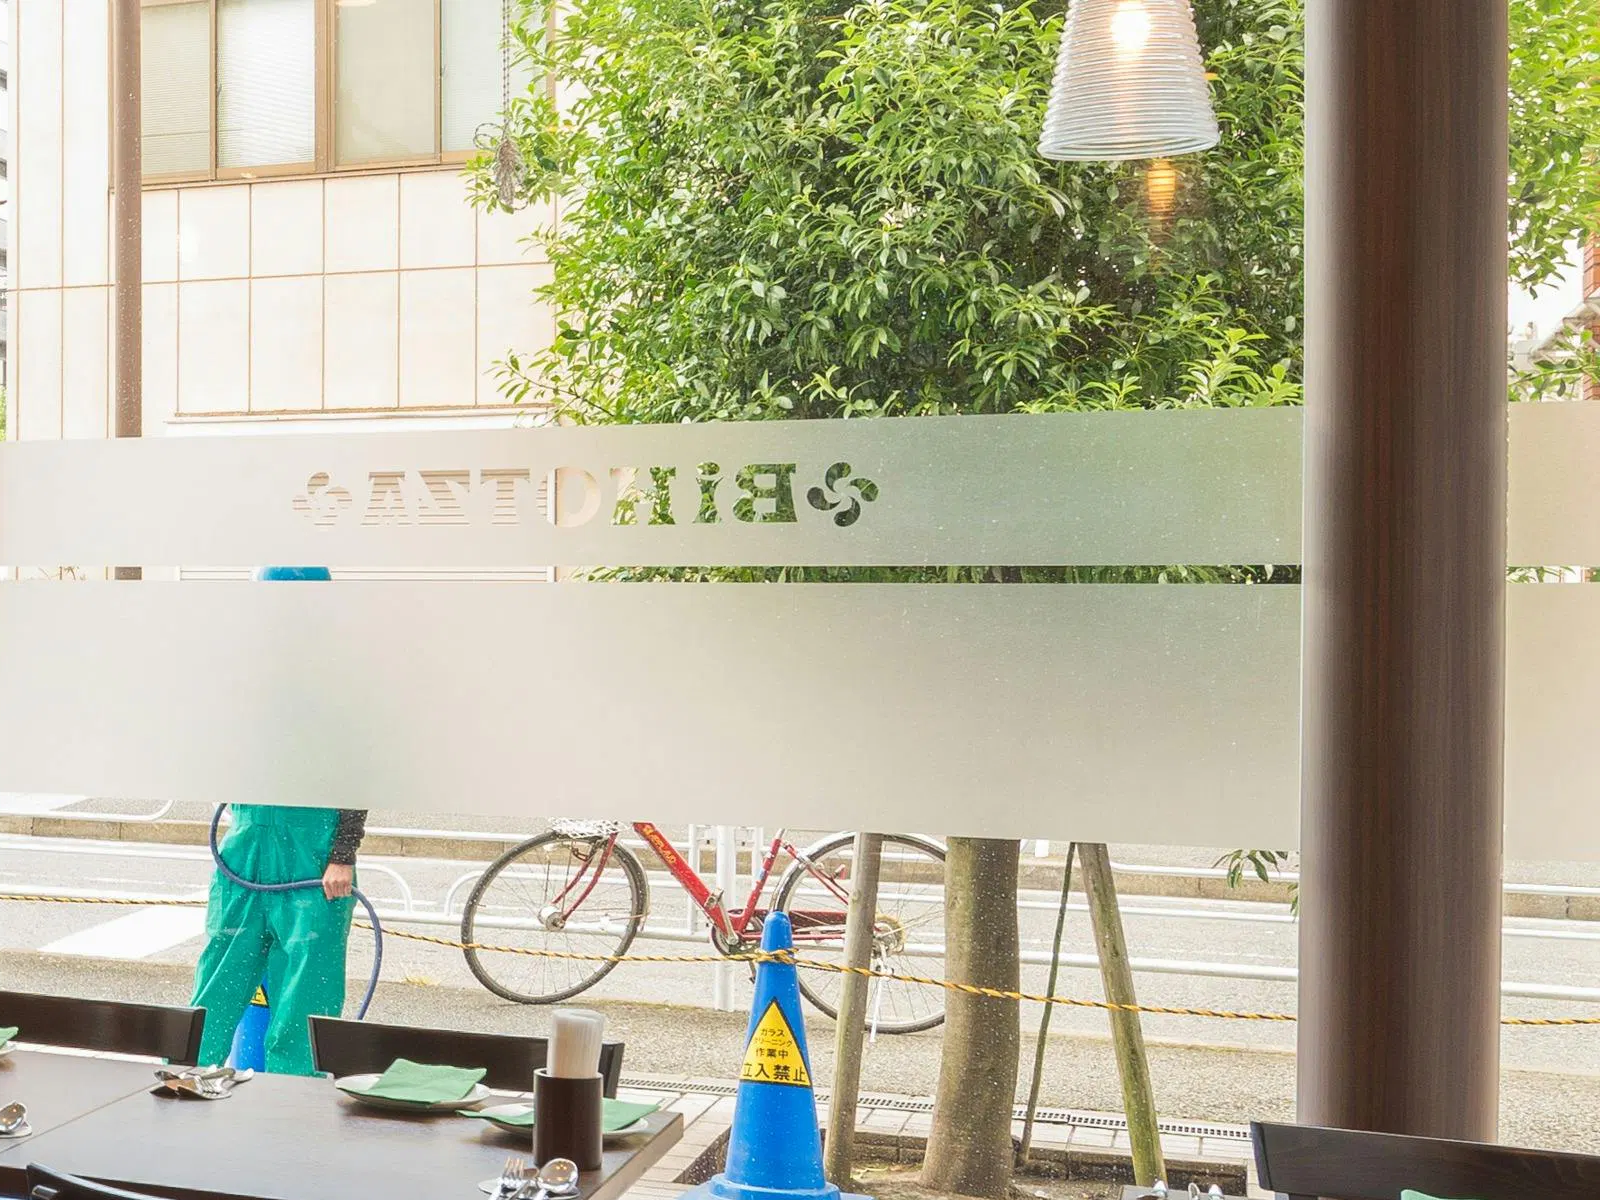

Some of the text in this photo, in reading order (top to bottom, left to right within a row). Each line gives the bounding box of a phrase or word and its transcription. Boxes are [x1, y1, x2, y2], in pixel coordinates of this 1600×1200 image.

[760, 1028, 785, 1037] ガラス
[755, 1047, 789, 1059] 作業中
[742, 1062, 806, 1083] 立入禁止
